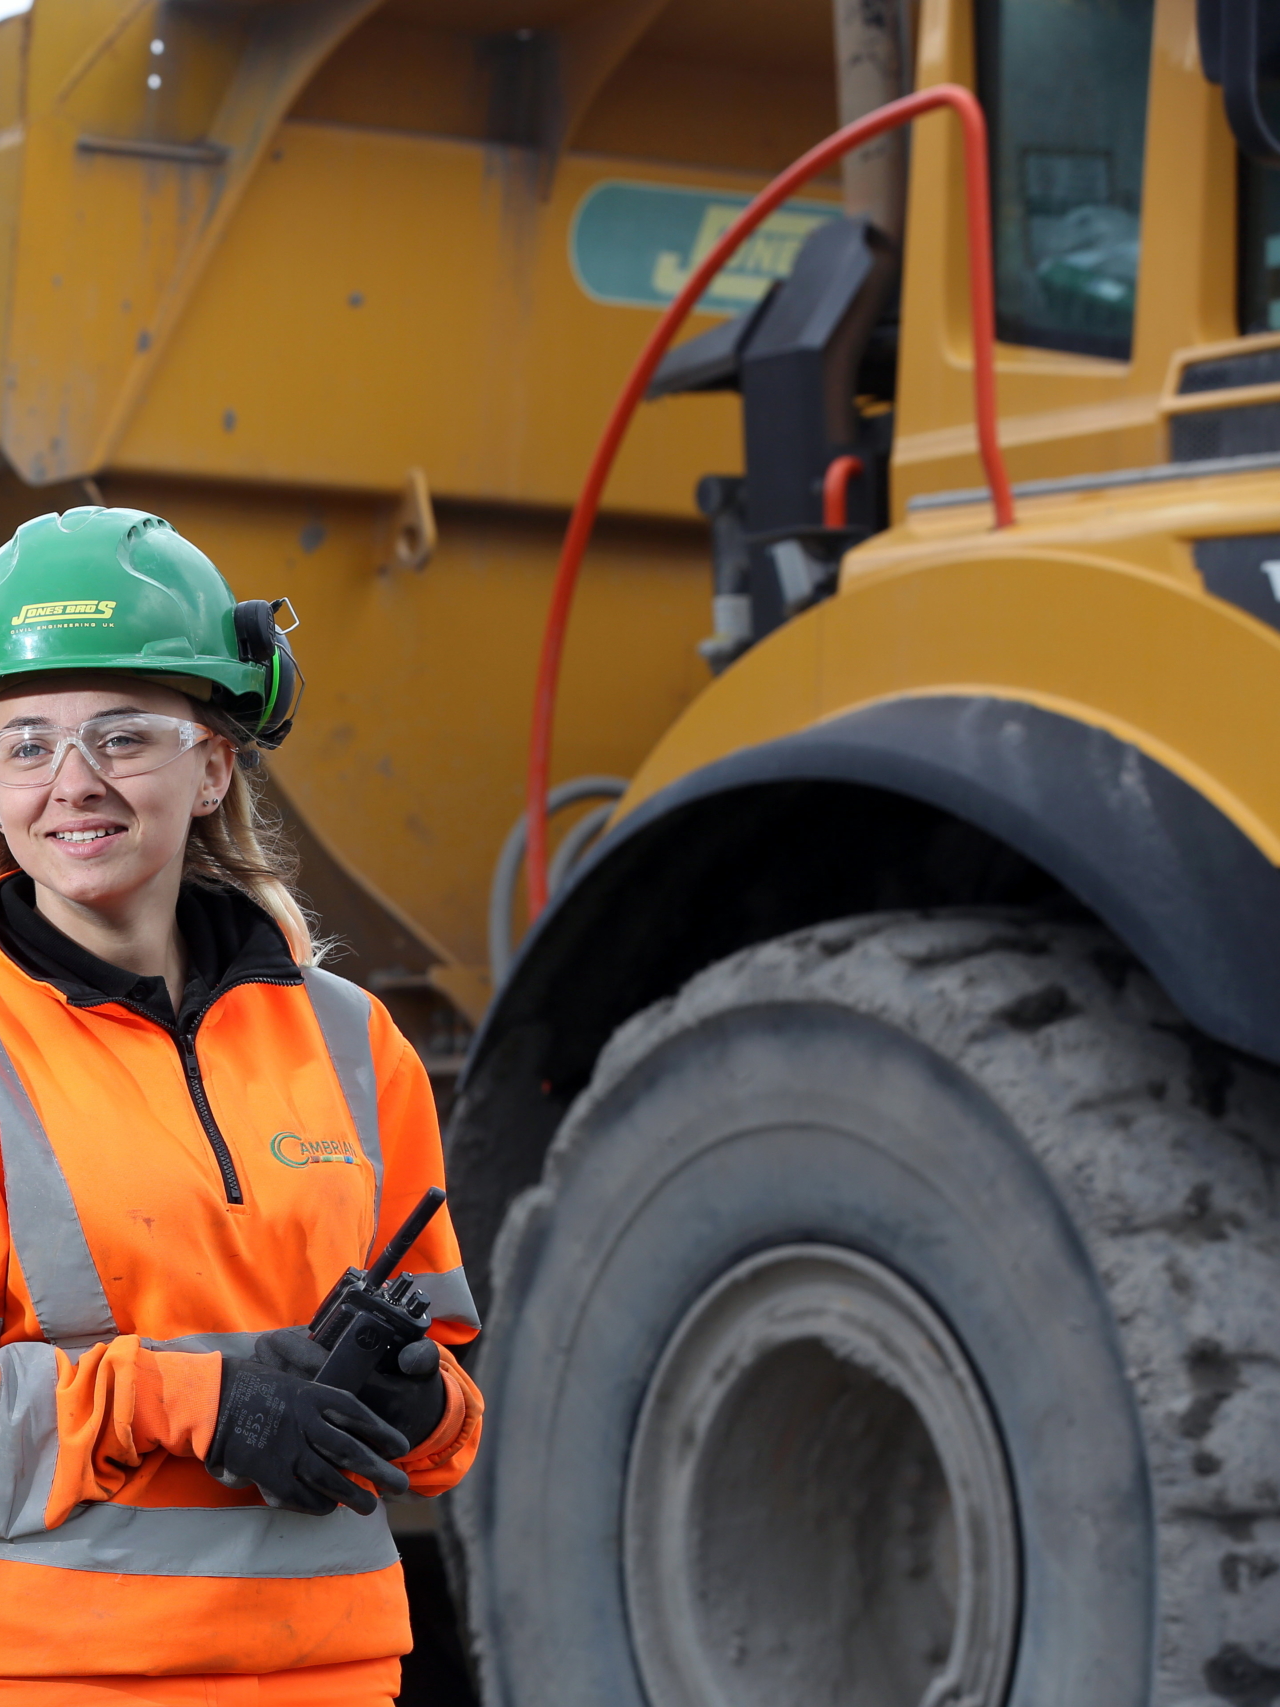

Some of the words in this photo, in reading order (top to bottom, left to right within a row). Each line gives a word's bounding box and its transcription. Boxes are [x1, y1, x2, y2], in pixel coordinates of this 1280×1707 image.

[11, 604, 64, 626] JONES
[65, 600, 117, 619] BROS
[10, 626, 32, 634] CIVIL
[36, 622, 96, 631] ENGINEERING
[270, 1131, 357, 1168] CAMBRIAN
[237, 1408, 247, 1425] Size
[257, 1397, 280, 1449] essentials
[234, 1426, 242, 1434] 9
